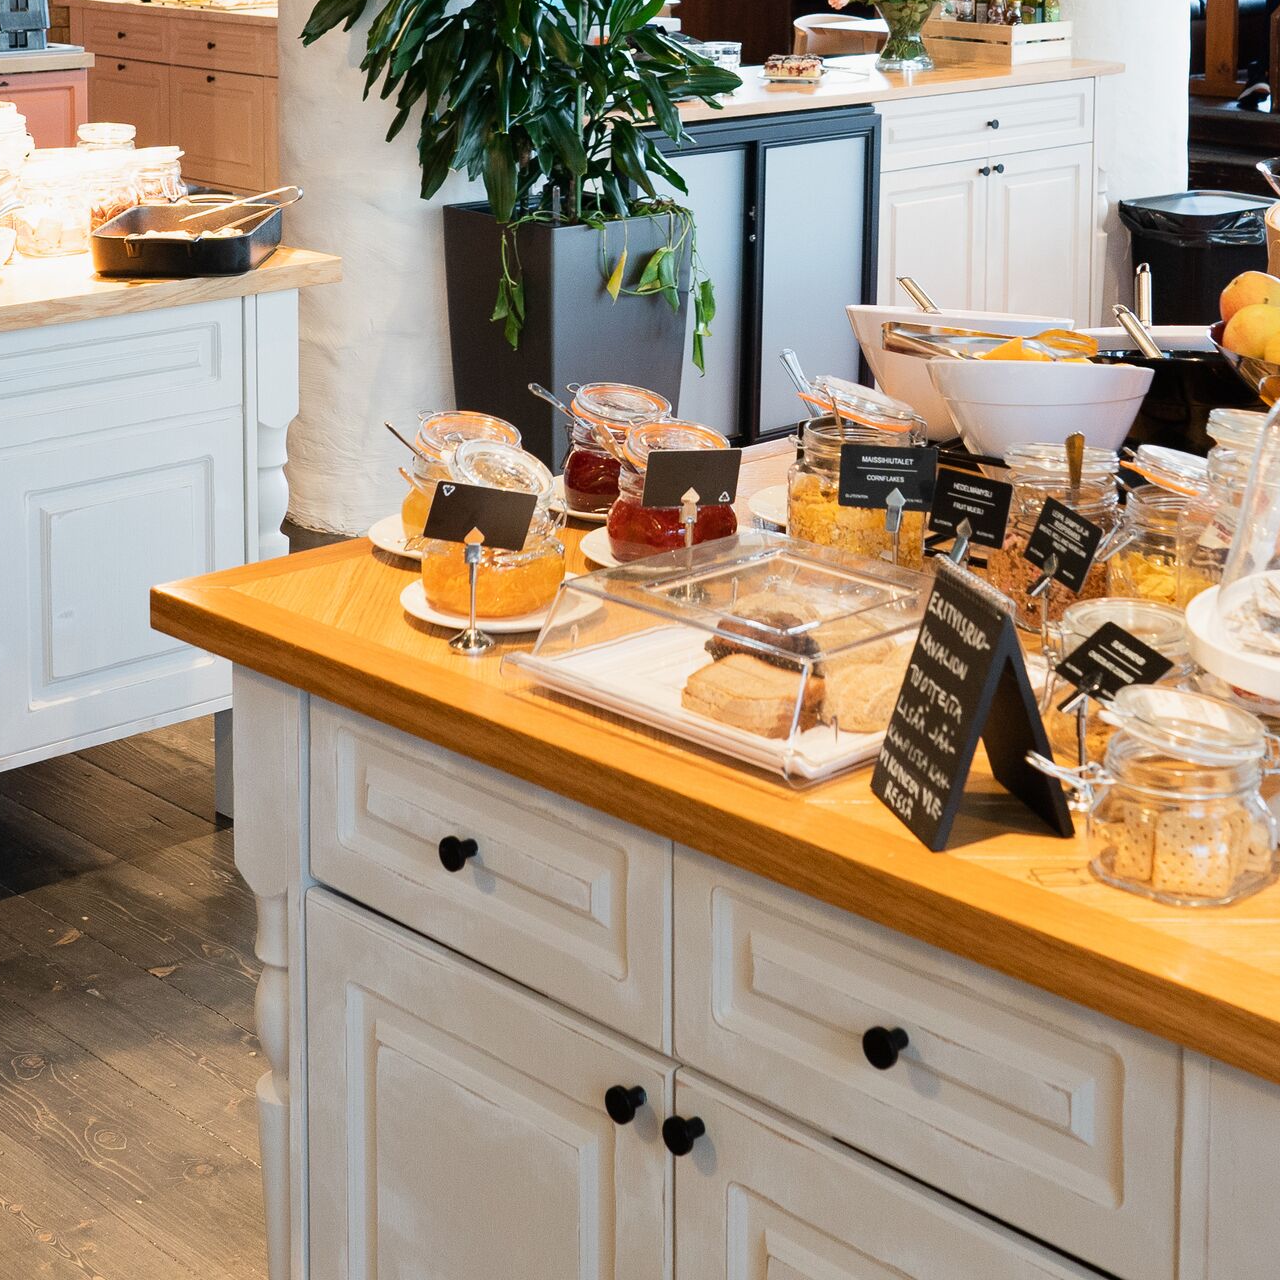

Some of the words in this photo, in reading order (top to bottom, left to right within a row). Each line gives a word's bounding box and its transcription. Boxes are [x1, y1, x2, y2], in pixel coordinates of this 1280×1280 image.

[866, 474, 905, 483] CORNFLAKES
[920, 625, 969, 681] KAVALION
[910, 663, 963, 724] TUOTTEITA
